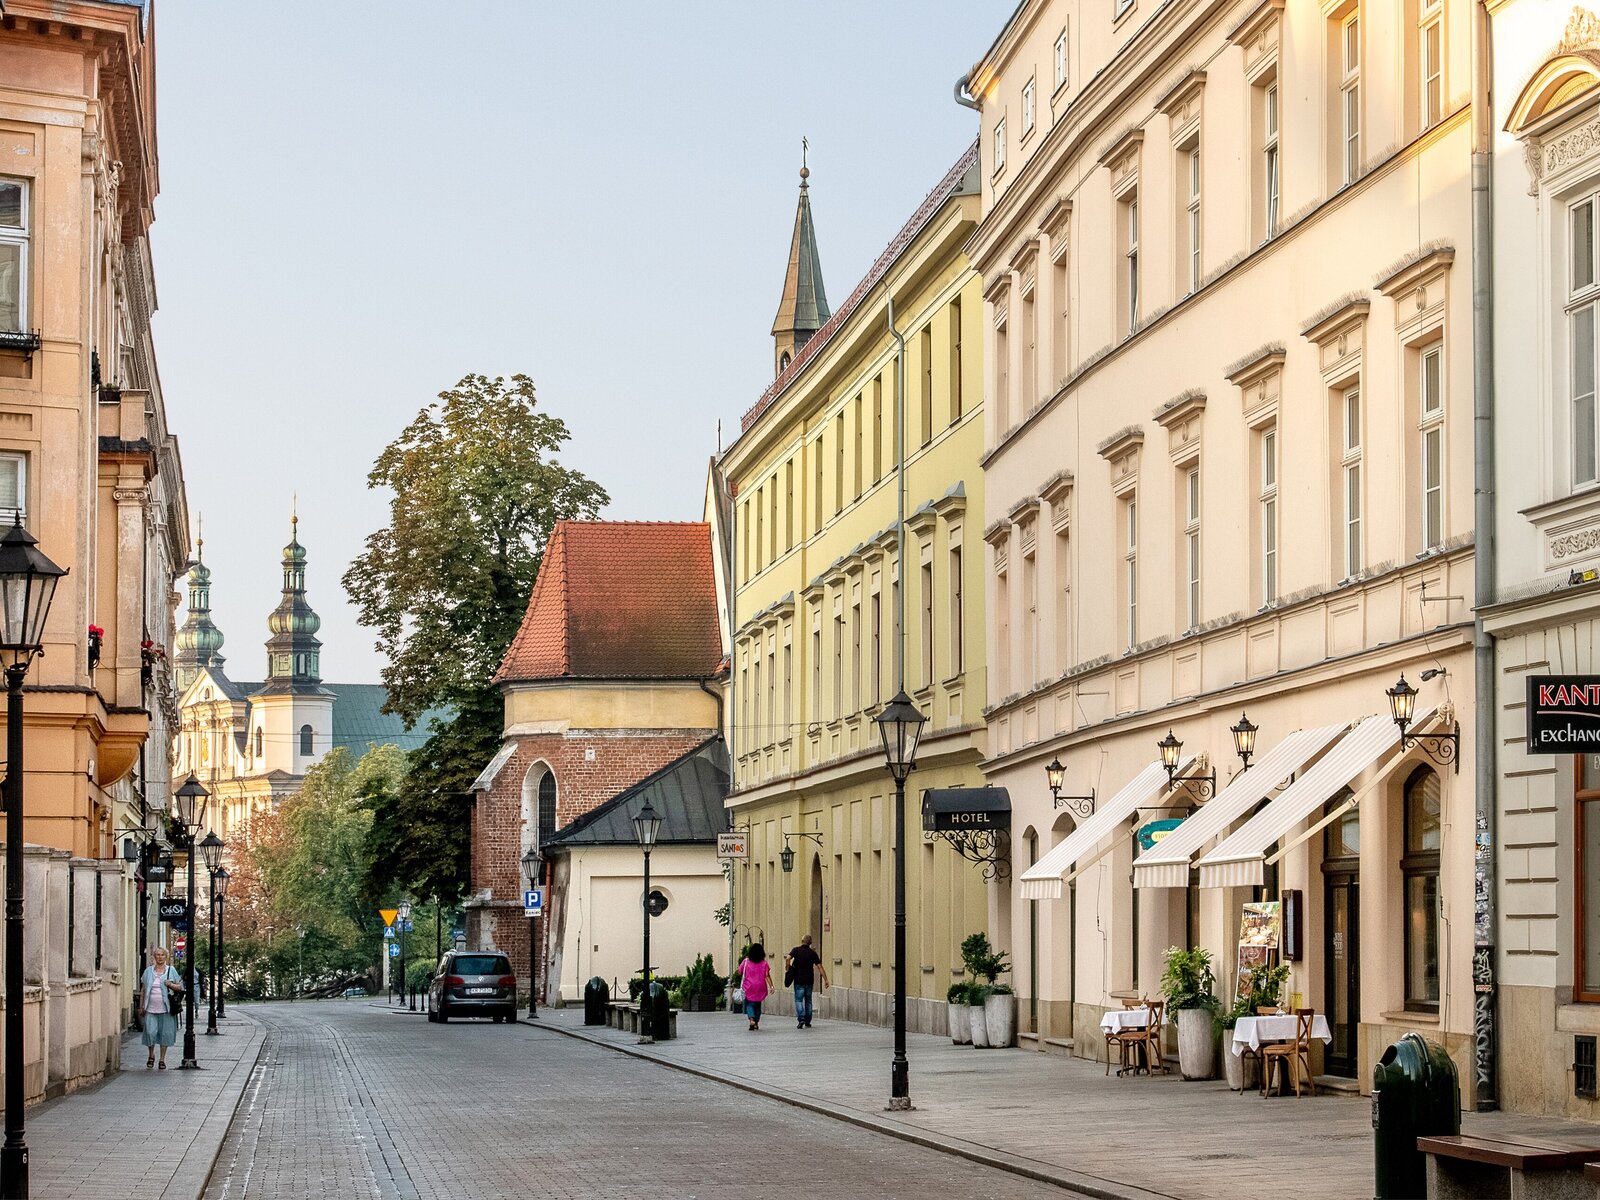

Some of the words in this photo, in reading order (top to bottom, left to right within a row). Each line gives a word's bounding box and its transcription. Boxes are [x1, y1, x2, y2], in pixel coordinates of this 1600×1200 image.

[1540, 685, 1600, 706] KANT
[951, 813, 990, 823] HOTEL
[720, 843, 744, 853] SANTOS
[528, 893, 538, 906] P
[23, 1153, 27, 1164] 6
